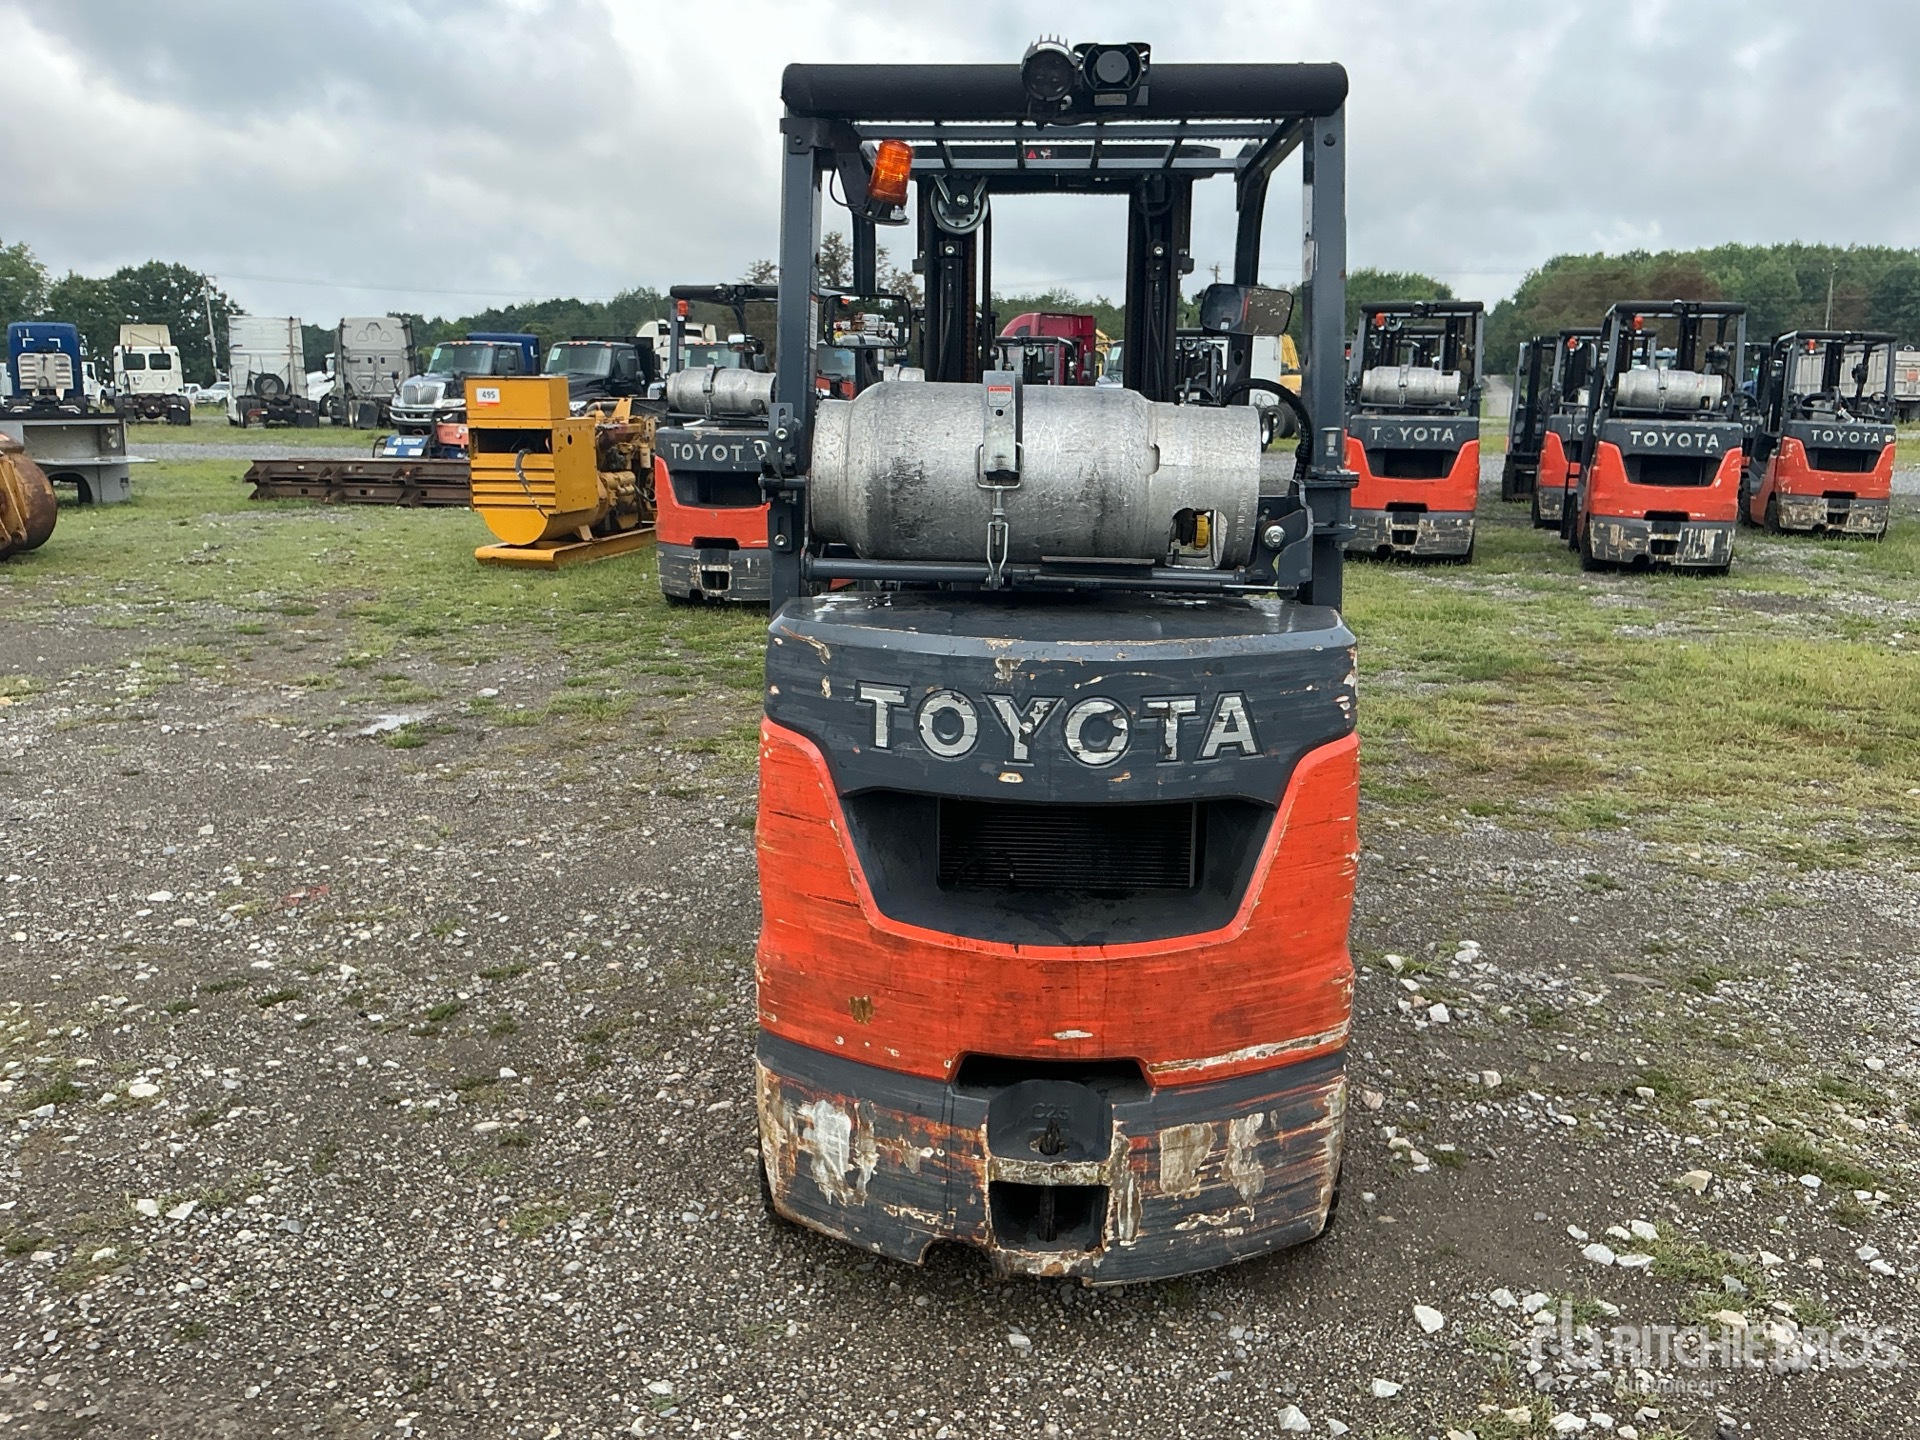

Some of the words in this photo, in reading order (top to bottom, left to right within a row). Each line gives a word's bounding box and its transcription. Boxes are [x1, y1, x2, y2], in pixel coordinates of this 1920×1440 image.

[481, 391, 496, 399] 495
[1630, 431, 1719, 448] TOYOTA
[1811, 429, 1879, 443] TOYOTA
[1237, 515, 1246, 524] IN
[856, 681, 1263, 768] TOYOTA
